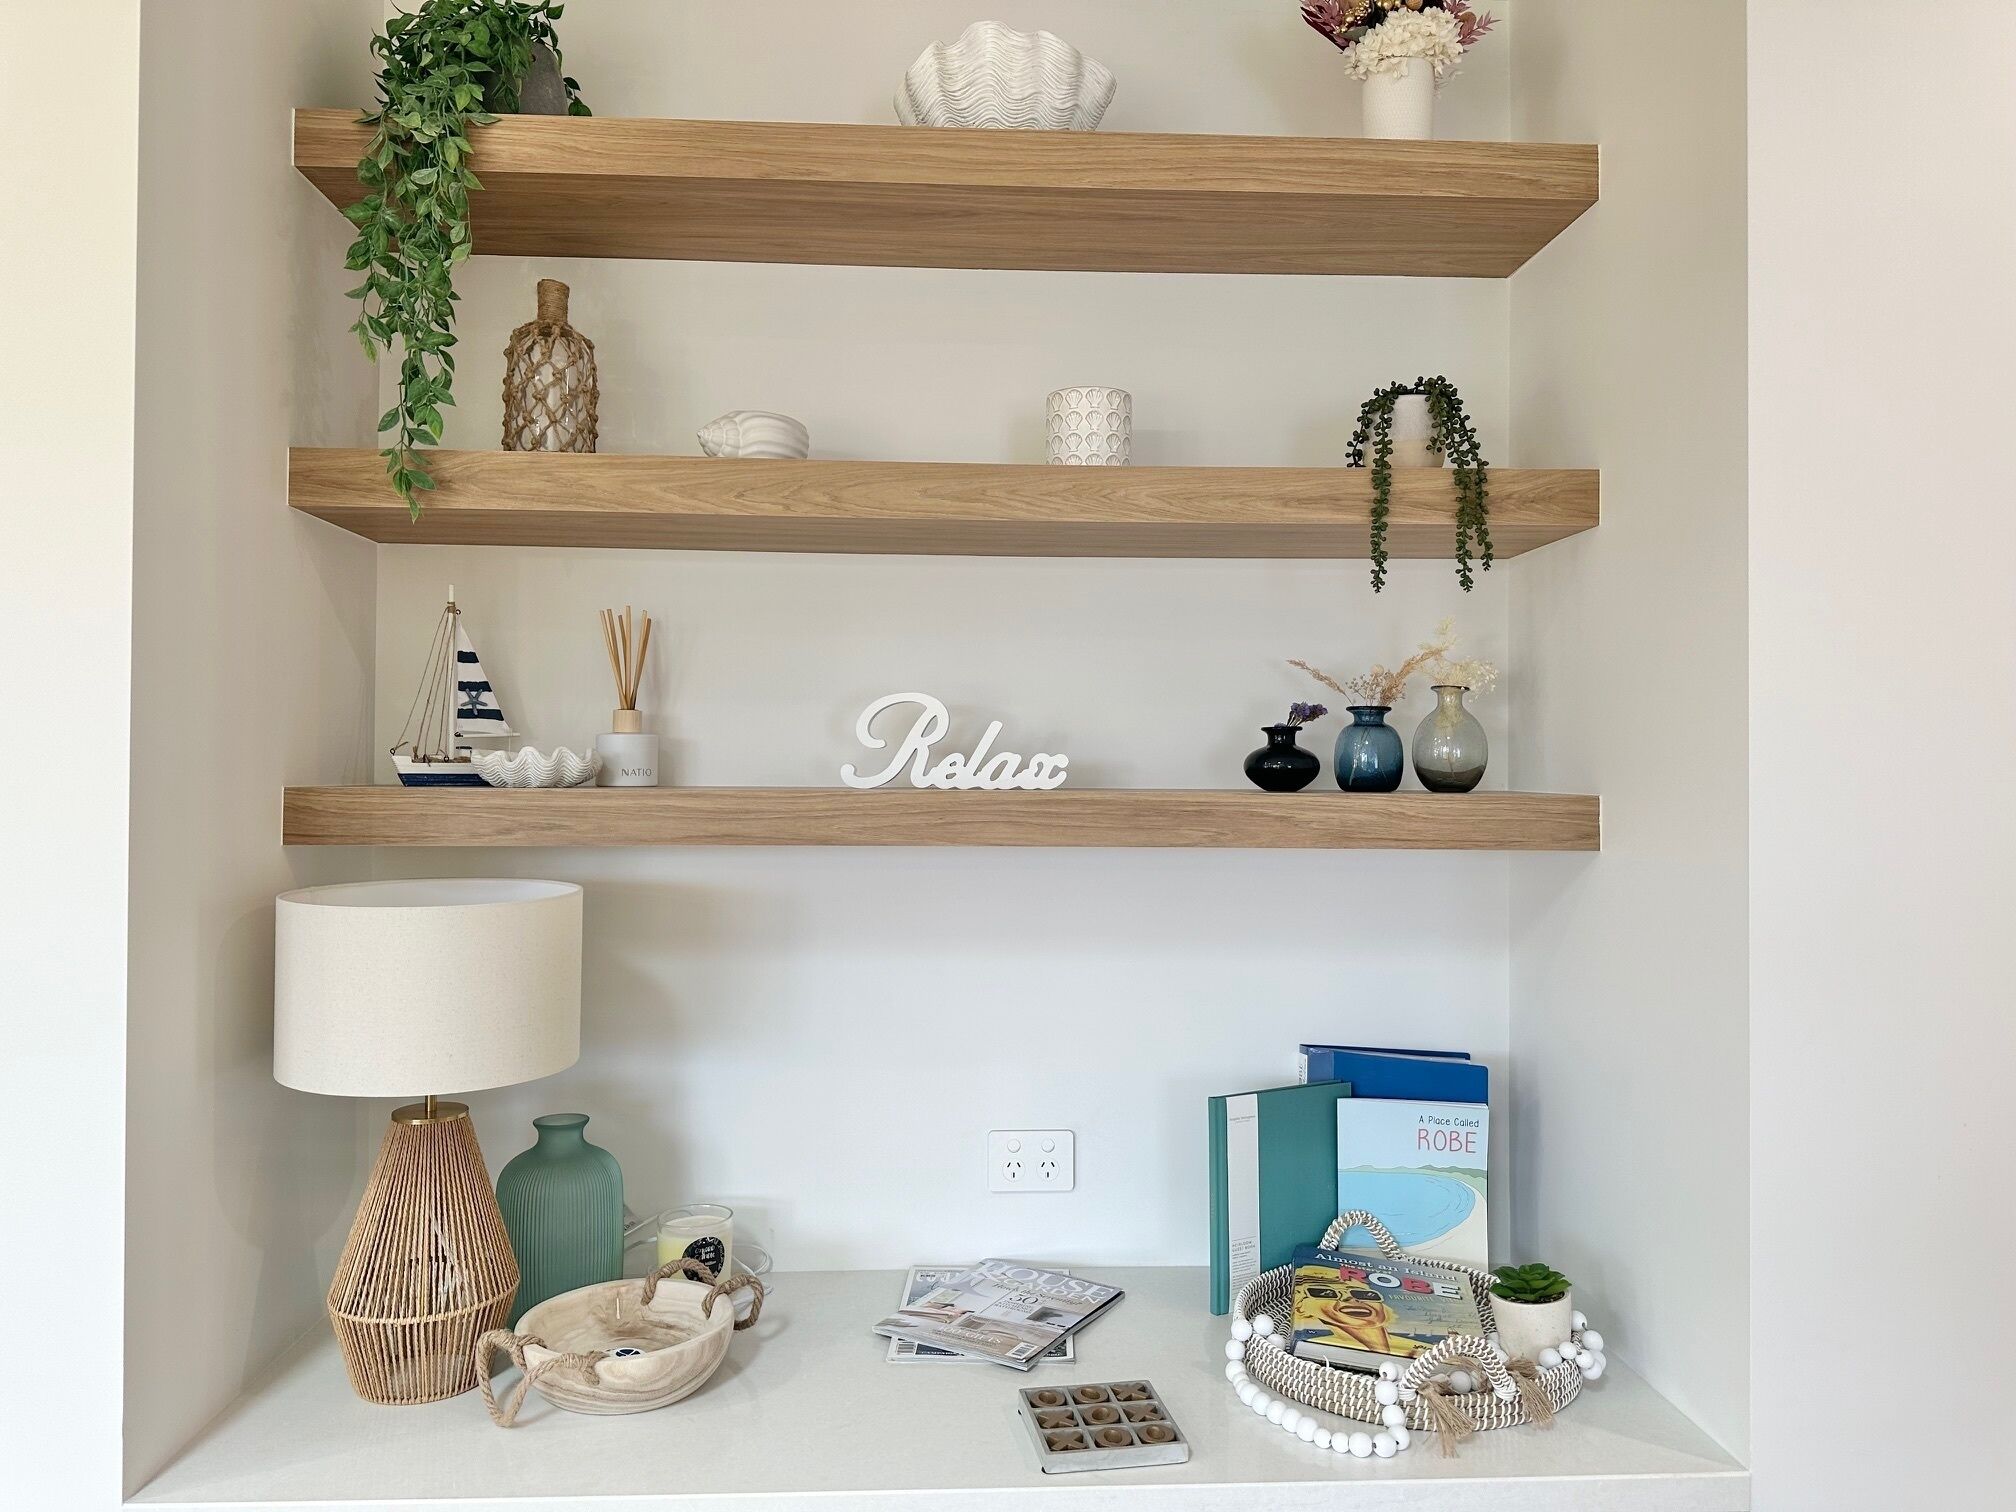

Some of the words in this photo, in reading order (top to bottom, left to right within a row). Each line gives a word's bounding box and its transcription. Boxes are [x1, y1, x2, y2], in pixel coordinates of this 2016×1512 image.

[840, 692, 1070, 790] Relax
[621, 768, 652, 777] NATIO
[1418, 1115, 1424, 1124] A
[1428, 1115, 1451, 1126] Place
[1454, 1117, 1480, 1128] Called
[1417, 1128, 1477, 1154] ROBE
[972, 1260, 1116, 1301] HOUSE
[1315, 1253, 1374, 1268] Almost
[1378, 1264, 1399, 1272] an
[1404, 1268, 1458, 1282] Island
[1339, 1265, 1463, 1301] ROBE
